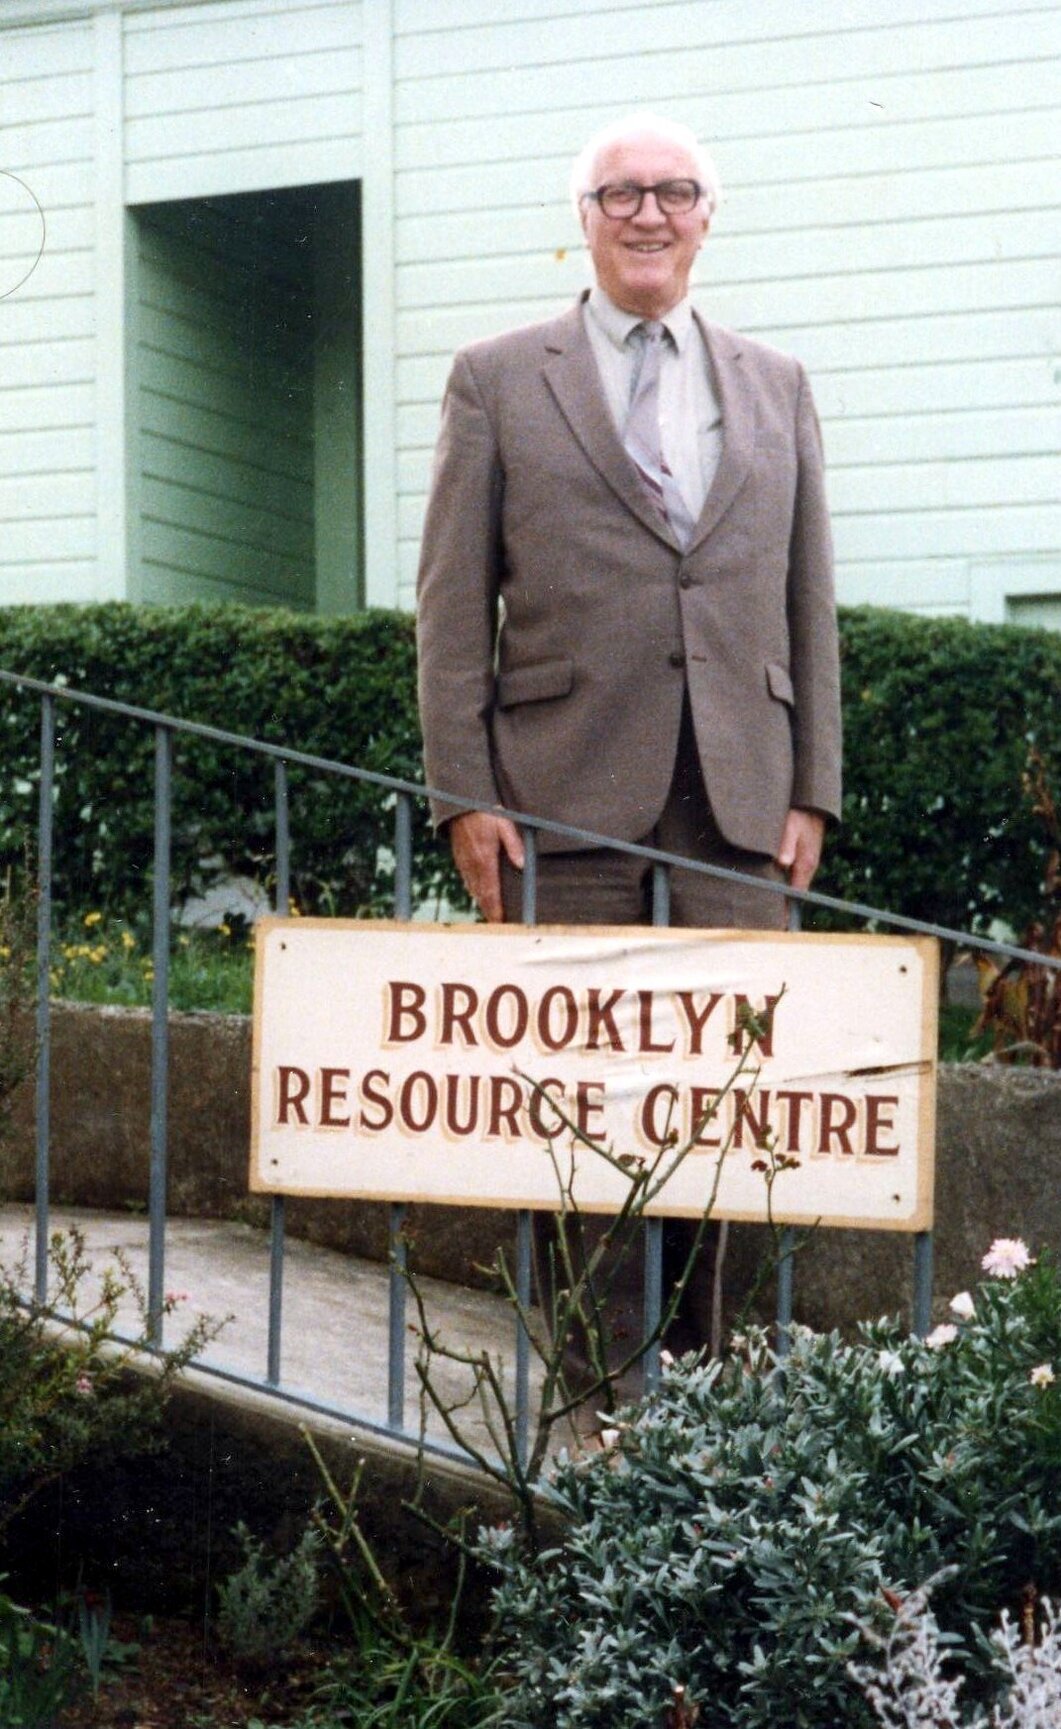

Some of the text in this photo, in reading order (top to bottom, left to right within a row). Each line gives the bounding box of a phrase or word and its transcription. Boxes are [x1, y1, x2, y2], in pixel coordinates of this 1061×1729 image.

[386, 981, 779, 1058] BROOKLYN
[276, 1065, 900, 1157] RESOURCE CENTRE
